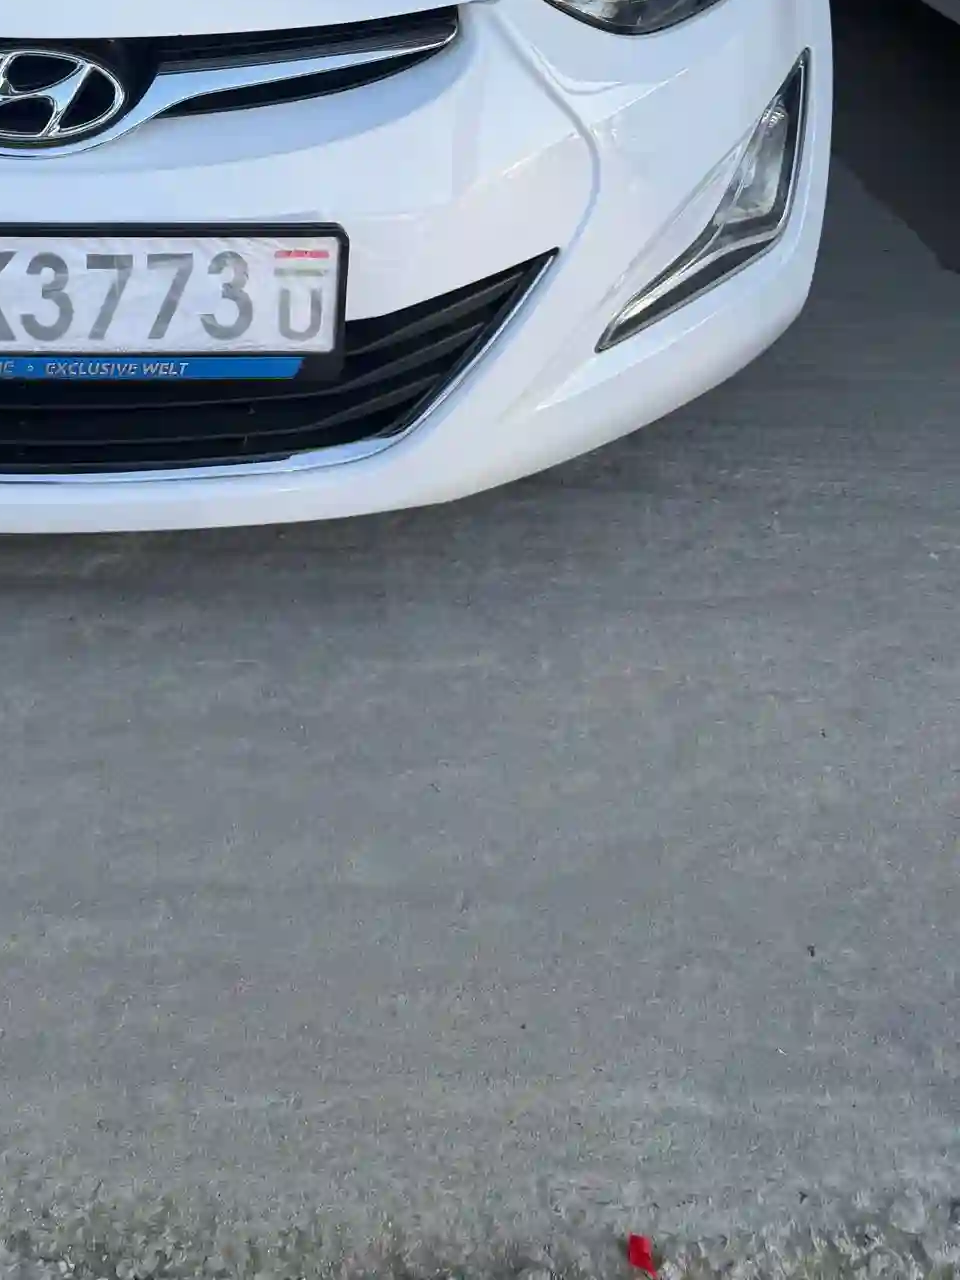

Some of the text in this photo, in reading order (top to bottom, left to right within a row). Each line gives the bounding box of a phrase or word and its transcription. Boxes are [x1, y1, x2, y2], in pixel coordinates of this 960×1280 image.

[278, 288, 323, 341] U
[45, 361, 138, 377] EXCLUSIVE
[142, 362, 189, 376] WELT
